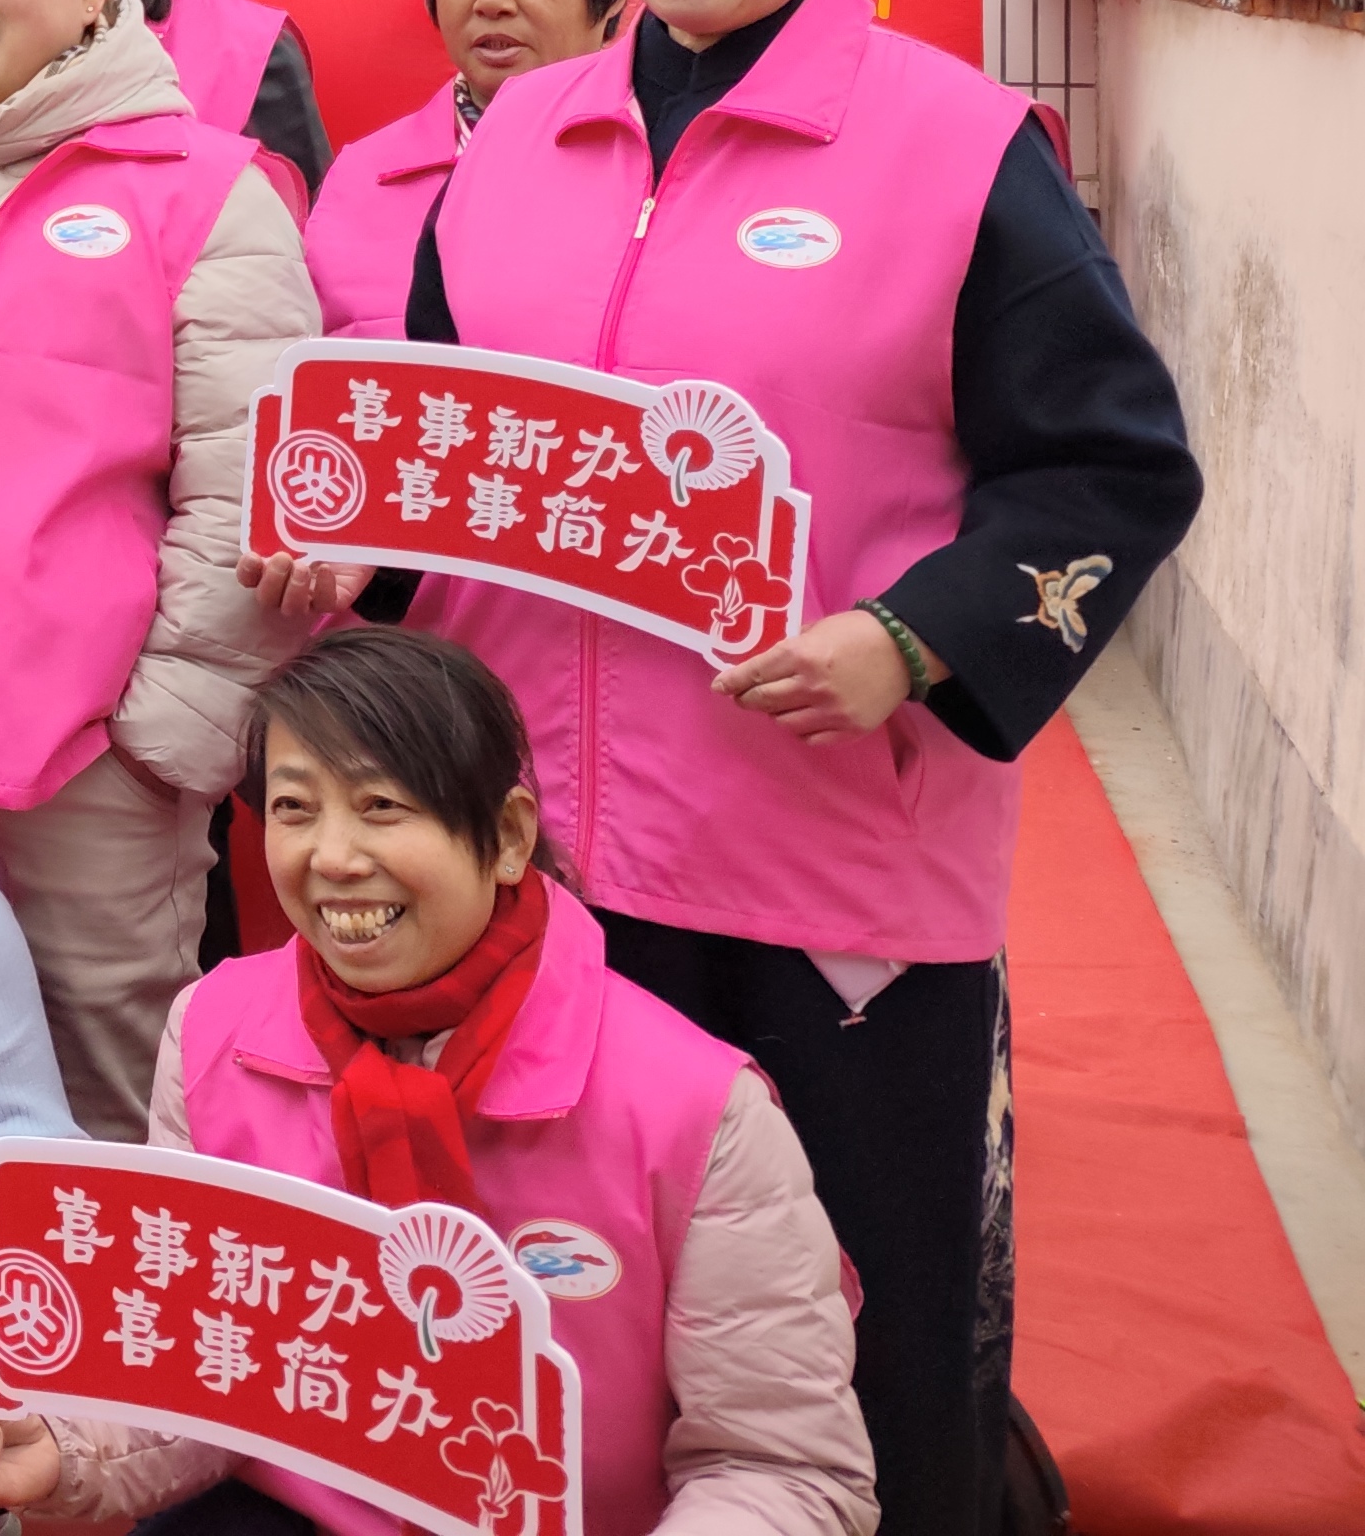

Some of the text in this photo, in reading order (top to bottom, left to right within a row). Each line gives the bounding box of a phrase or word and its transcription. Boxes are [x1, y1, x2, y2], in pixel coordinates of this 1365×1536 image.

[337, 377, 644, 488] 喜事新办
[384, 458, 696, 573] 喜事简办
[43, 1186, 386, 1332] 喜事新办
[103, 1287, 454, 1442] 喜事简办
